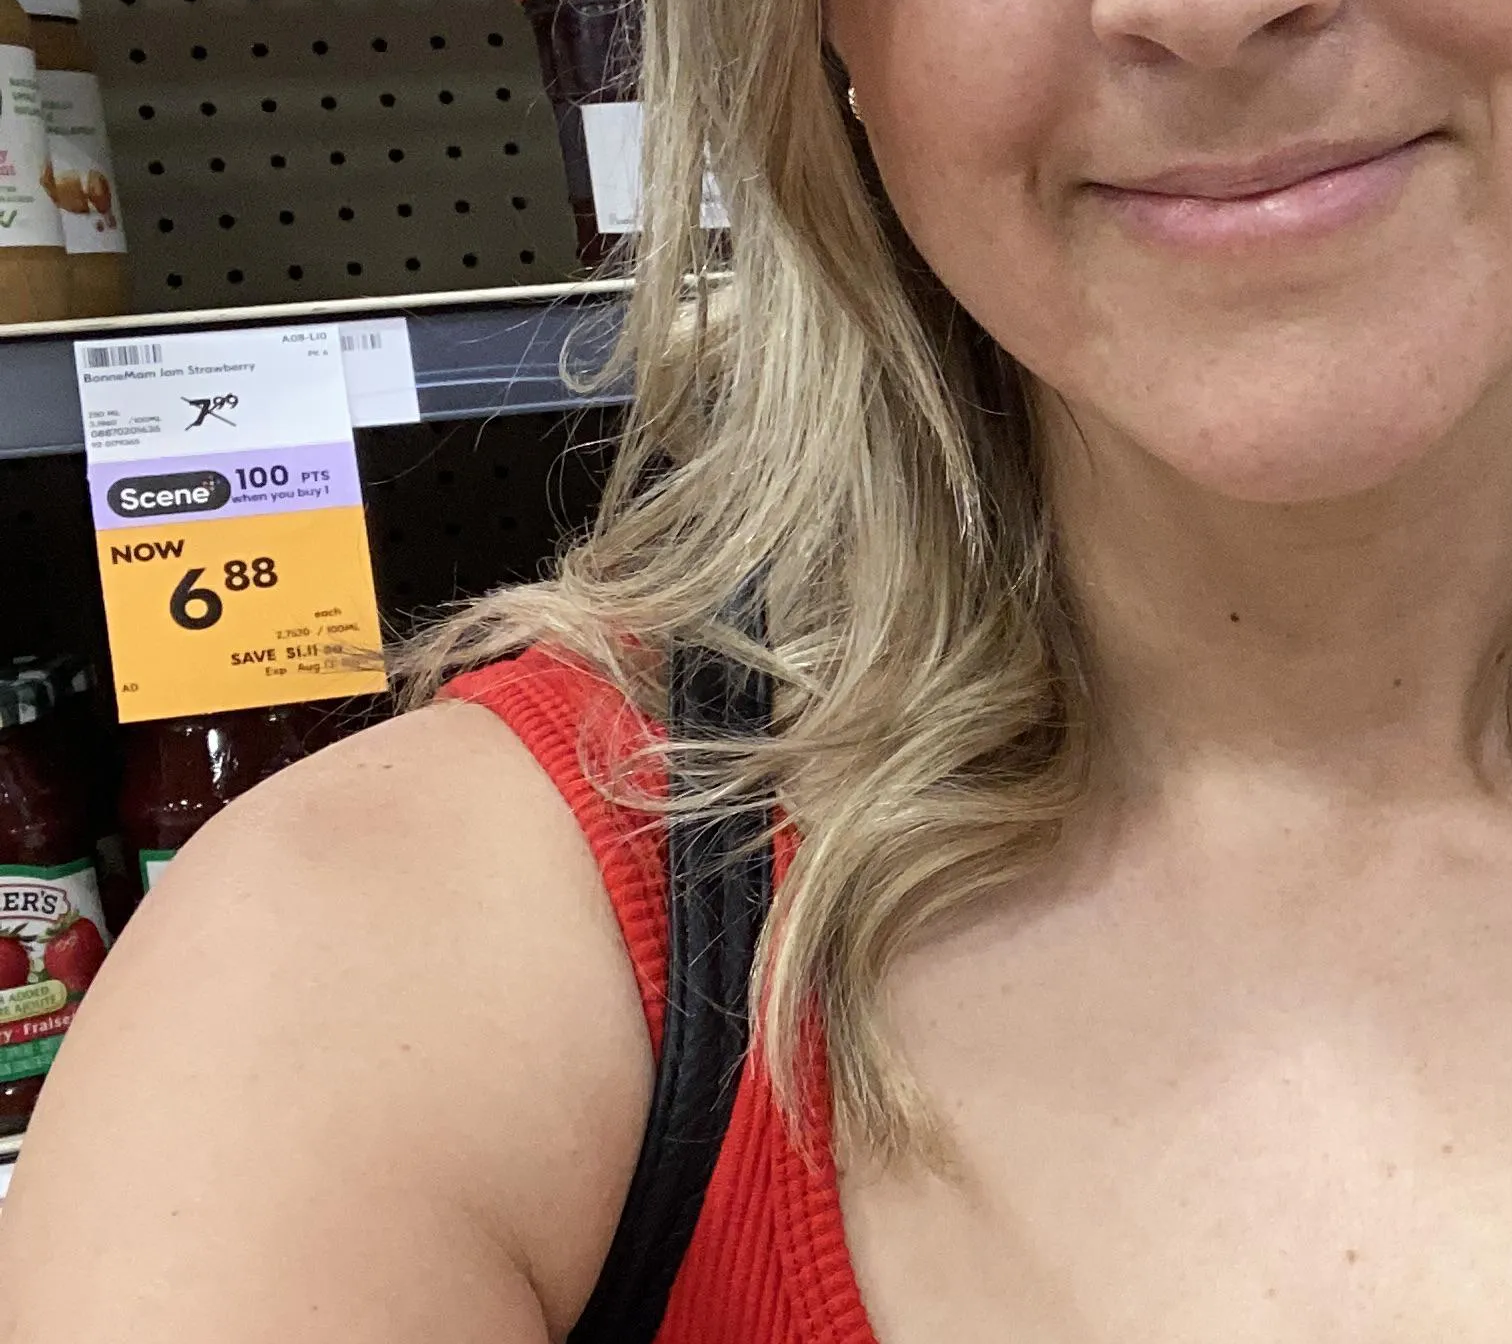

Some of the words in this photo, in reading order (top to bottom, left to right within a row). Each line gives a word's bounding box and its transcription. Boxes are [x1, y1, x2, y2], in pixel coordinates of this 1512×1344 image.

[84, 371, 156, 384] BonneMam
[160, 367, 184, 379] Jam
[188, 362, 256, 376] Strawberry
[235, 465, 289, 490] 100
[301, 470, 331, 484] PTS
[231, 492, 268, 504] when
[270, 490, 295, 503] you
[297, 487, 322, 500] buy
[111, 539, 185, 564] NOW
[314, 608, 342, 619] each
[231, 649, 276, 666] SAVE
[265, 666, 287, 676] Exp
[298, 662, 320, 674] Aug
[121, 683, 139, 693] AD
